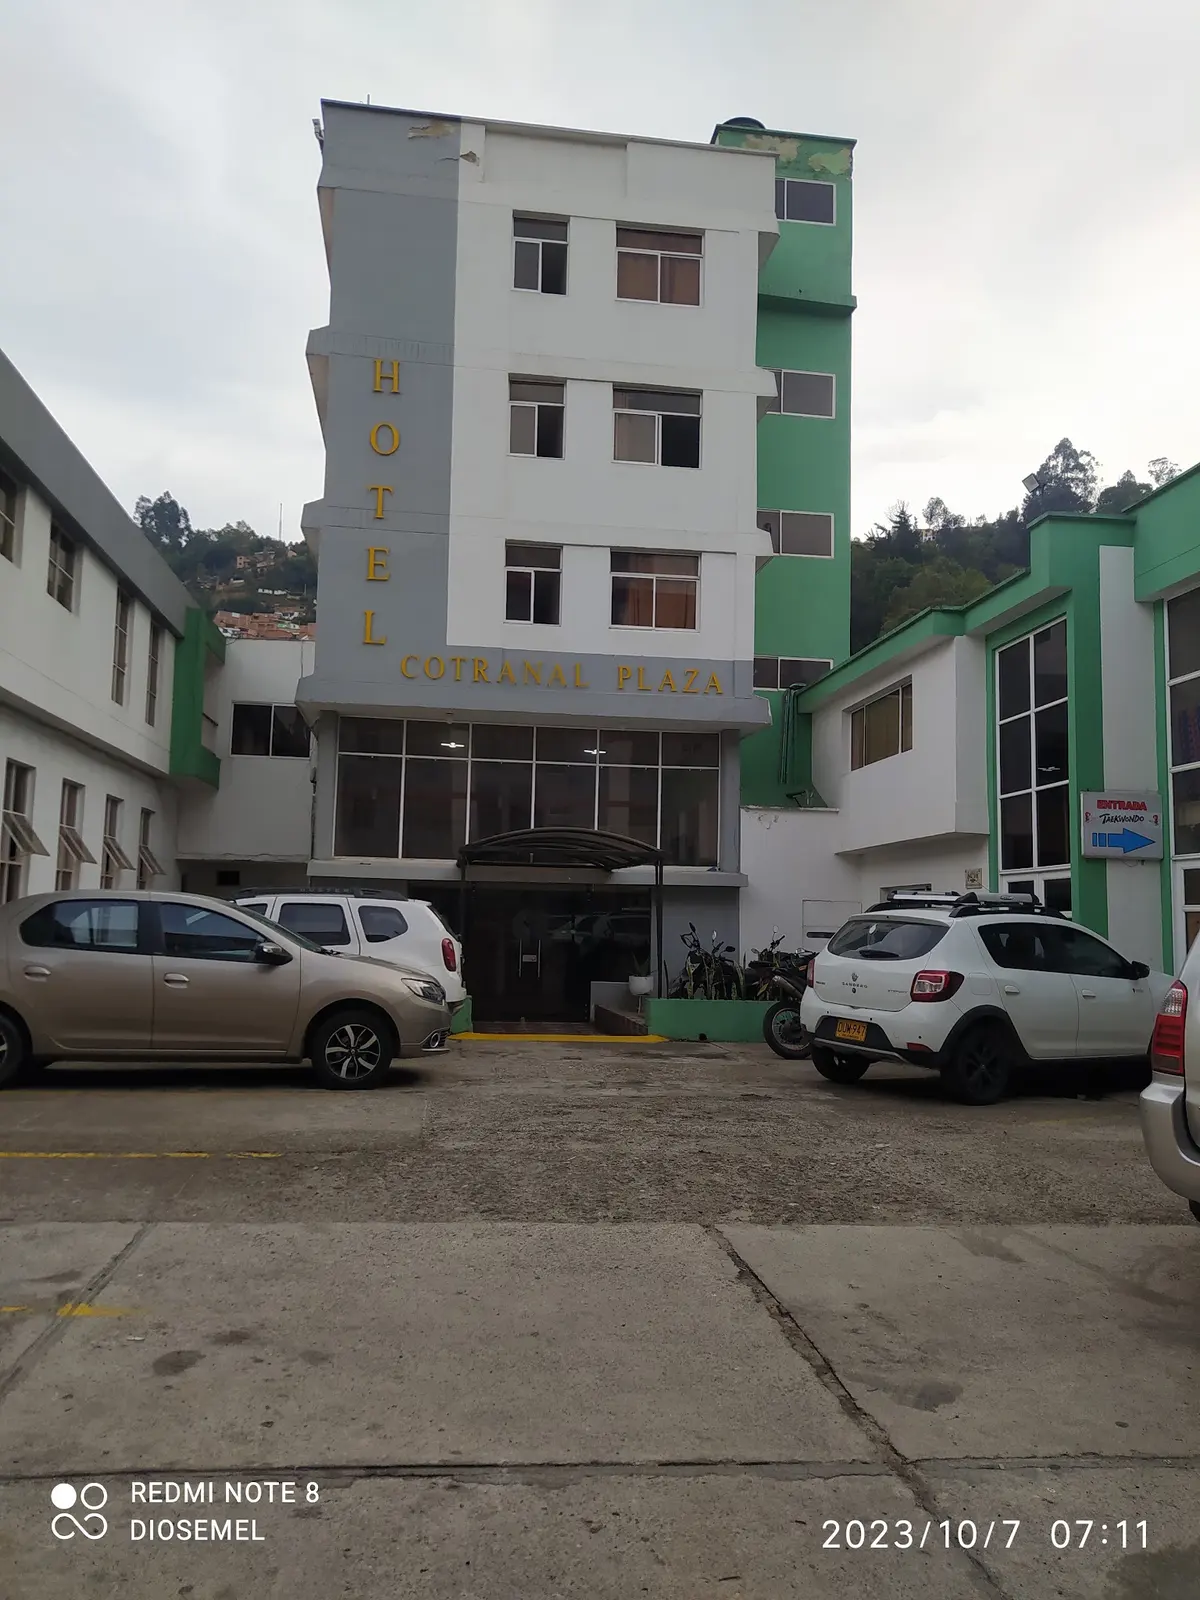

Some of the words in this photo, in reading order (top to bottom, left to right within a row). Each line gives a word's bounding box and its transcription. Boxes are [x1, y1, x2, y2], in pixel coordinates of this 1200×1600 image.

[363, 358, 400, 645] HOTEL
[401, 654, 590, 688] COTRANAL
[617, 665, 724, 694] PLAZA
[1096, 799, 1147, 811] ENTRADA
